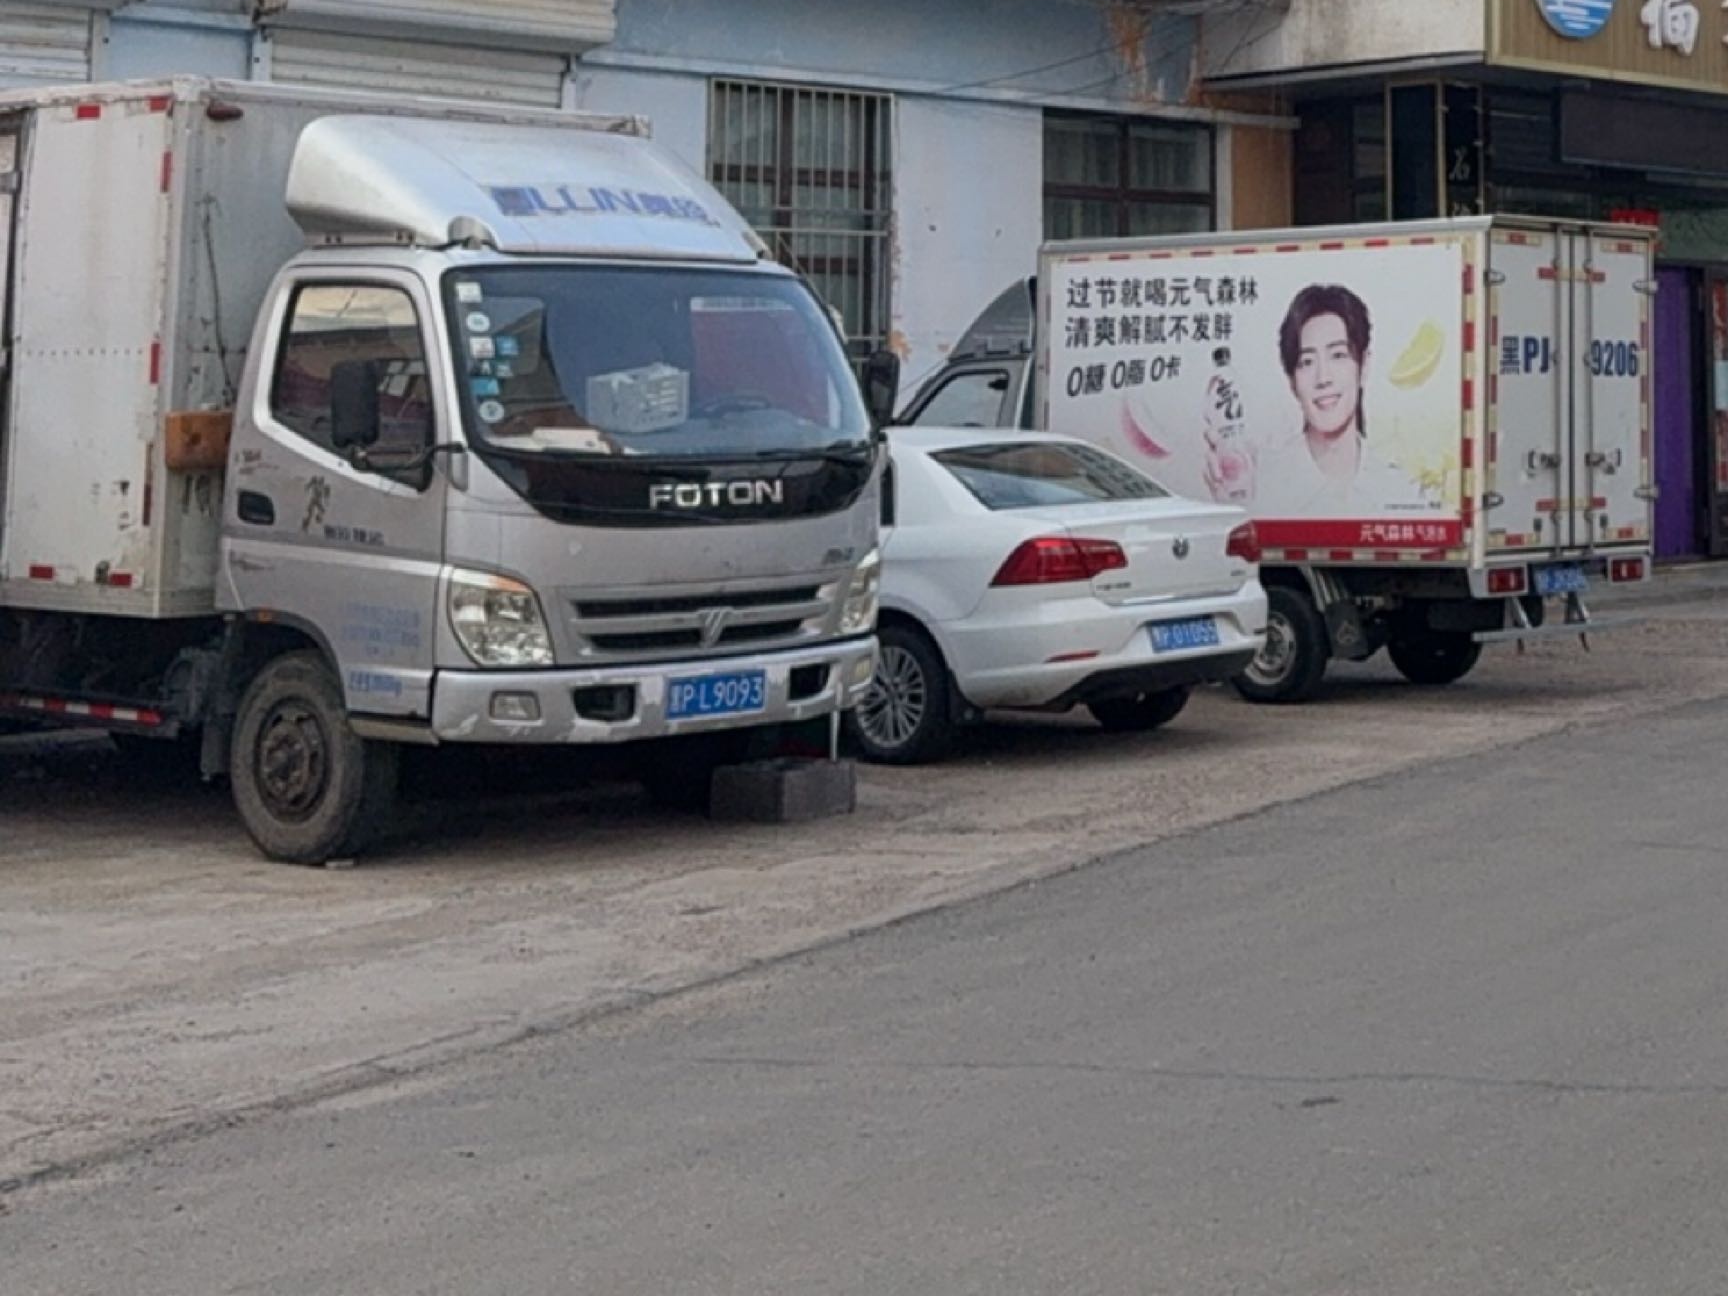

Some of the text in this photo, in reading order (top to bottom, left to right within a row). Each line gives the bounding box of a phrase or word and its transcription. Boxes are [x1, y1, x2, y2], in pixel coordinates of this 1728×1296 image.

[1066, 275, 1259, 309] 过节就喝元气森林
[1065, 311, 1233, 348] 清爽解腻不发胖
[1591, 340, 1638, 378] 9206
[650, 479, 784, 510] FOTON
